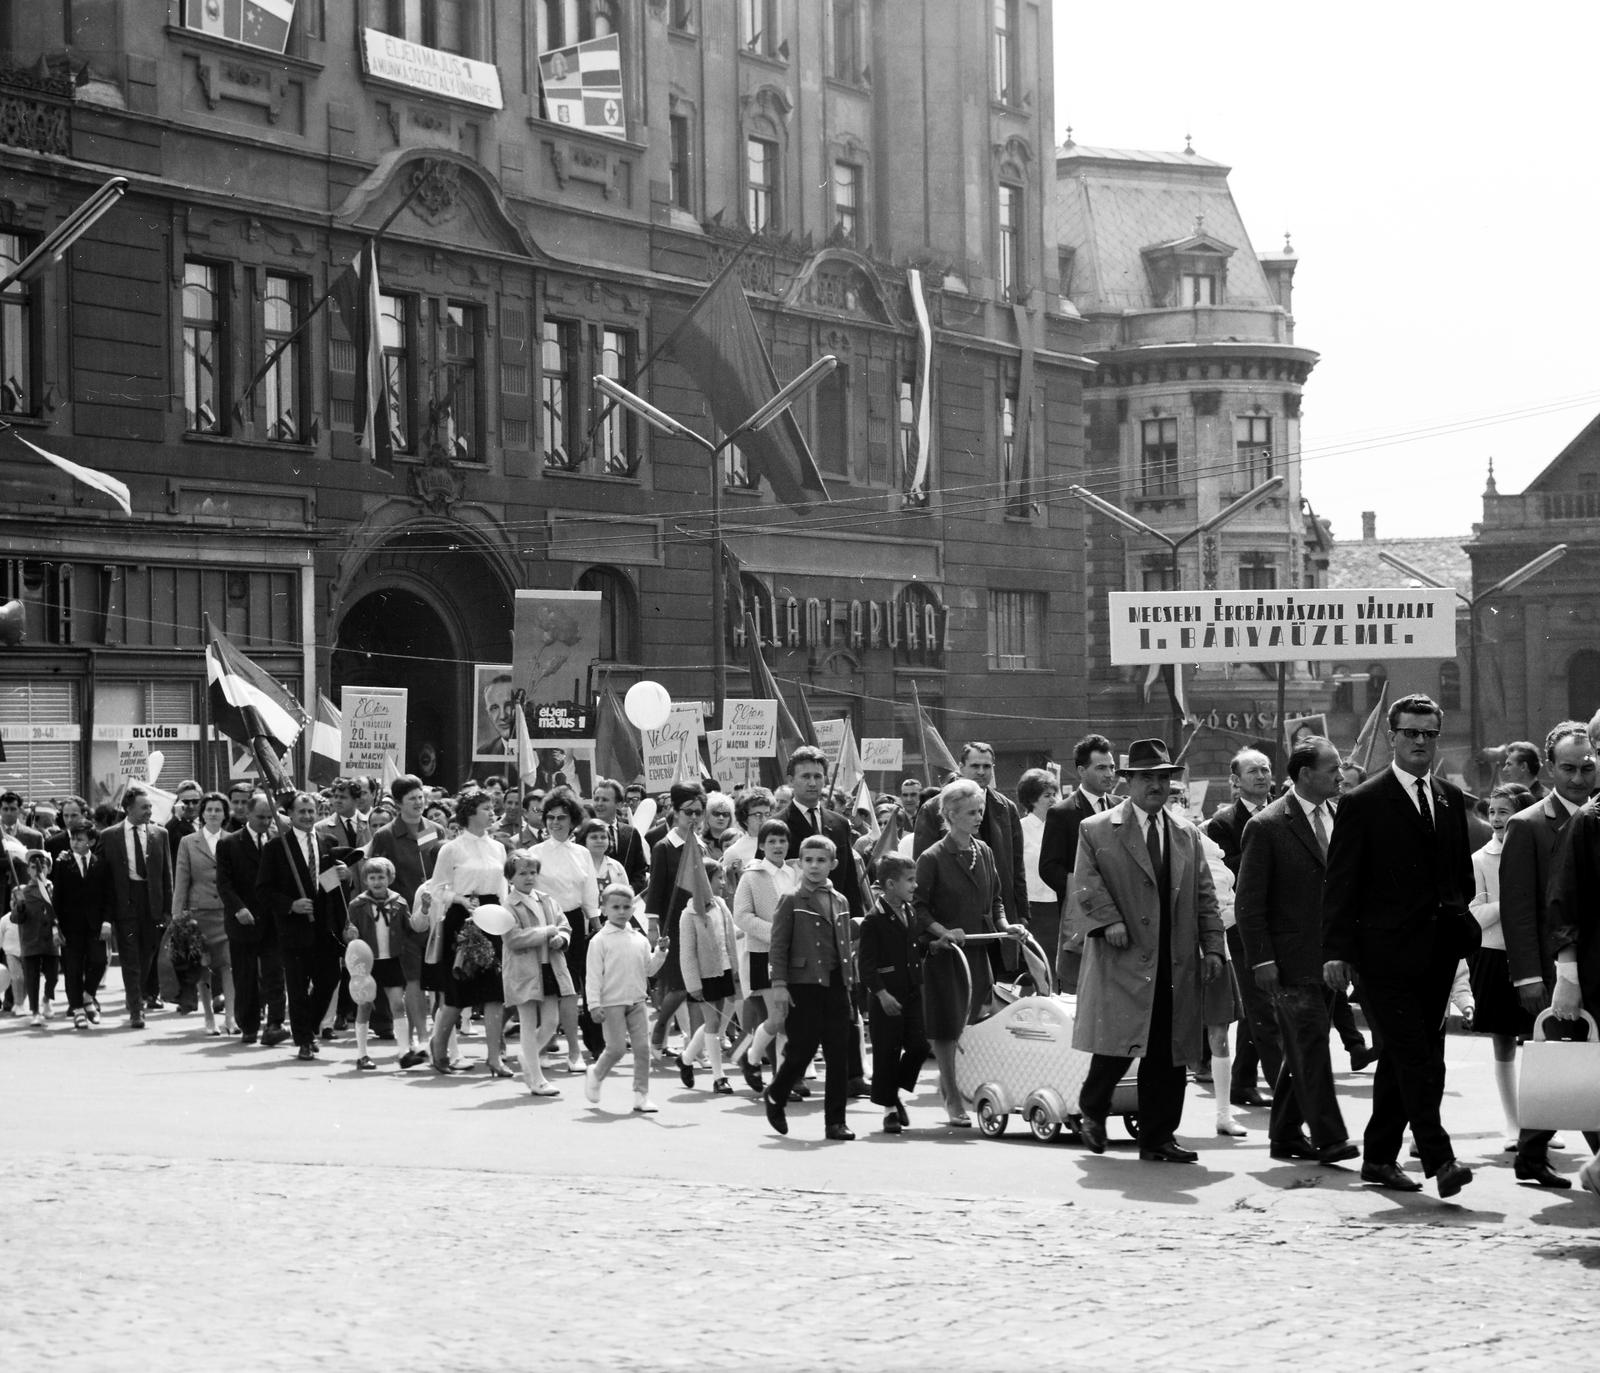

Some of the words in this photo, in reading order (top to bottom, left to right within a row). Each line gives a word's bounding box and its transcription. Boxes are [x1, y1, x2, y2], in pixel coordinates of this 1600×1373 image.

[462, 61, 472, 79] 1
[1214, 597, 1344, 622] ÉRCBÁNYÁSZATI
[1357, 595, 1435, 620] VÁLLALAT
[132, 725, 178, 738] OLCSÓBB
[352, 728, 368, 741] 20.
